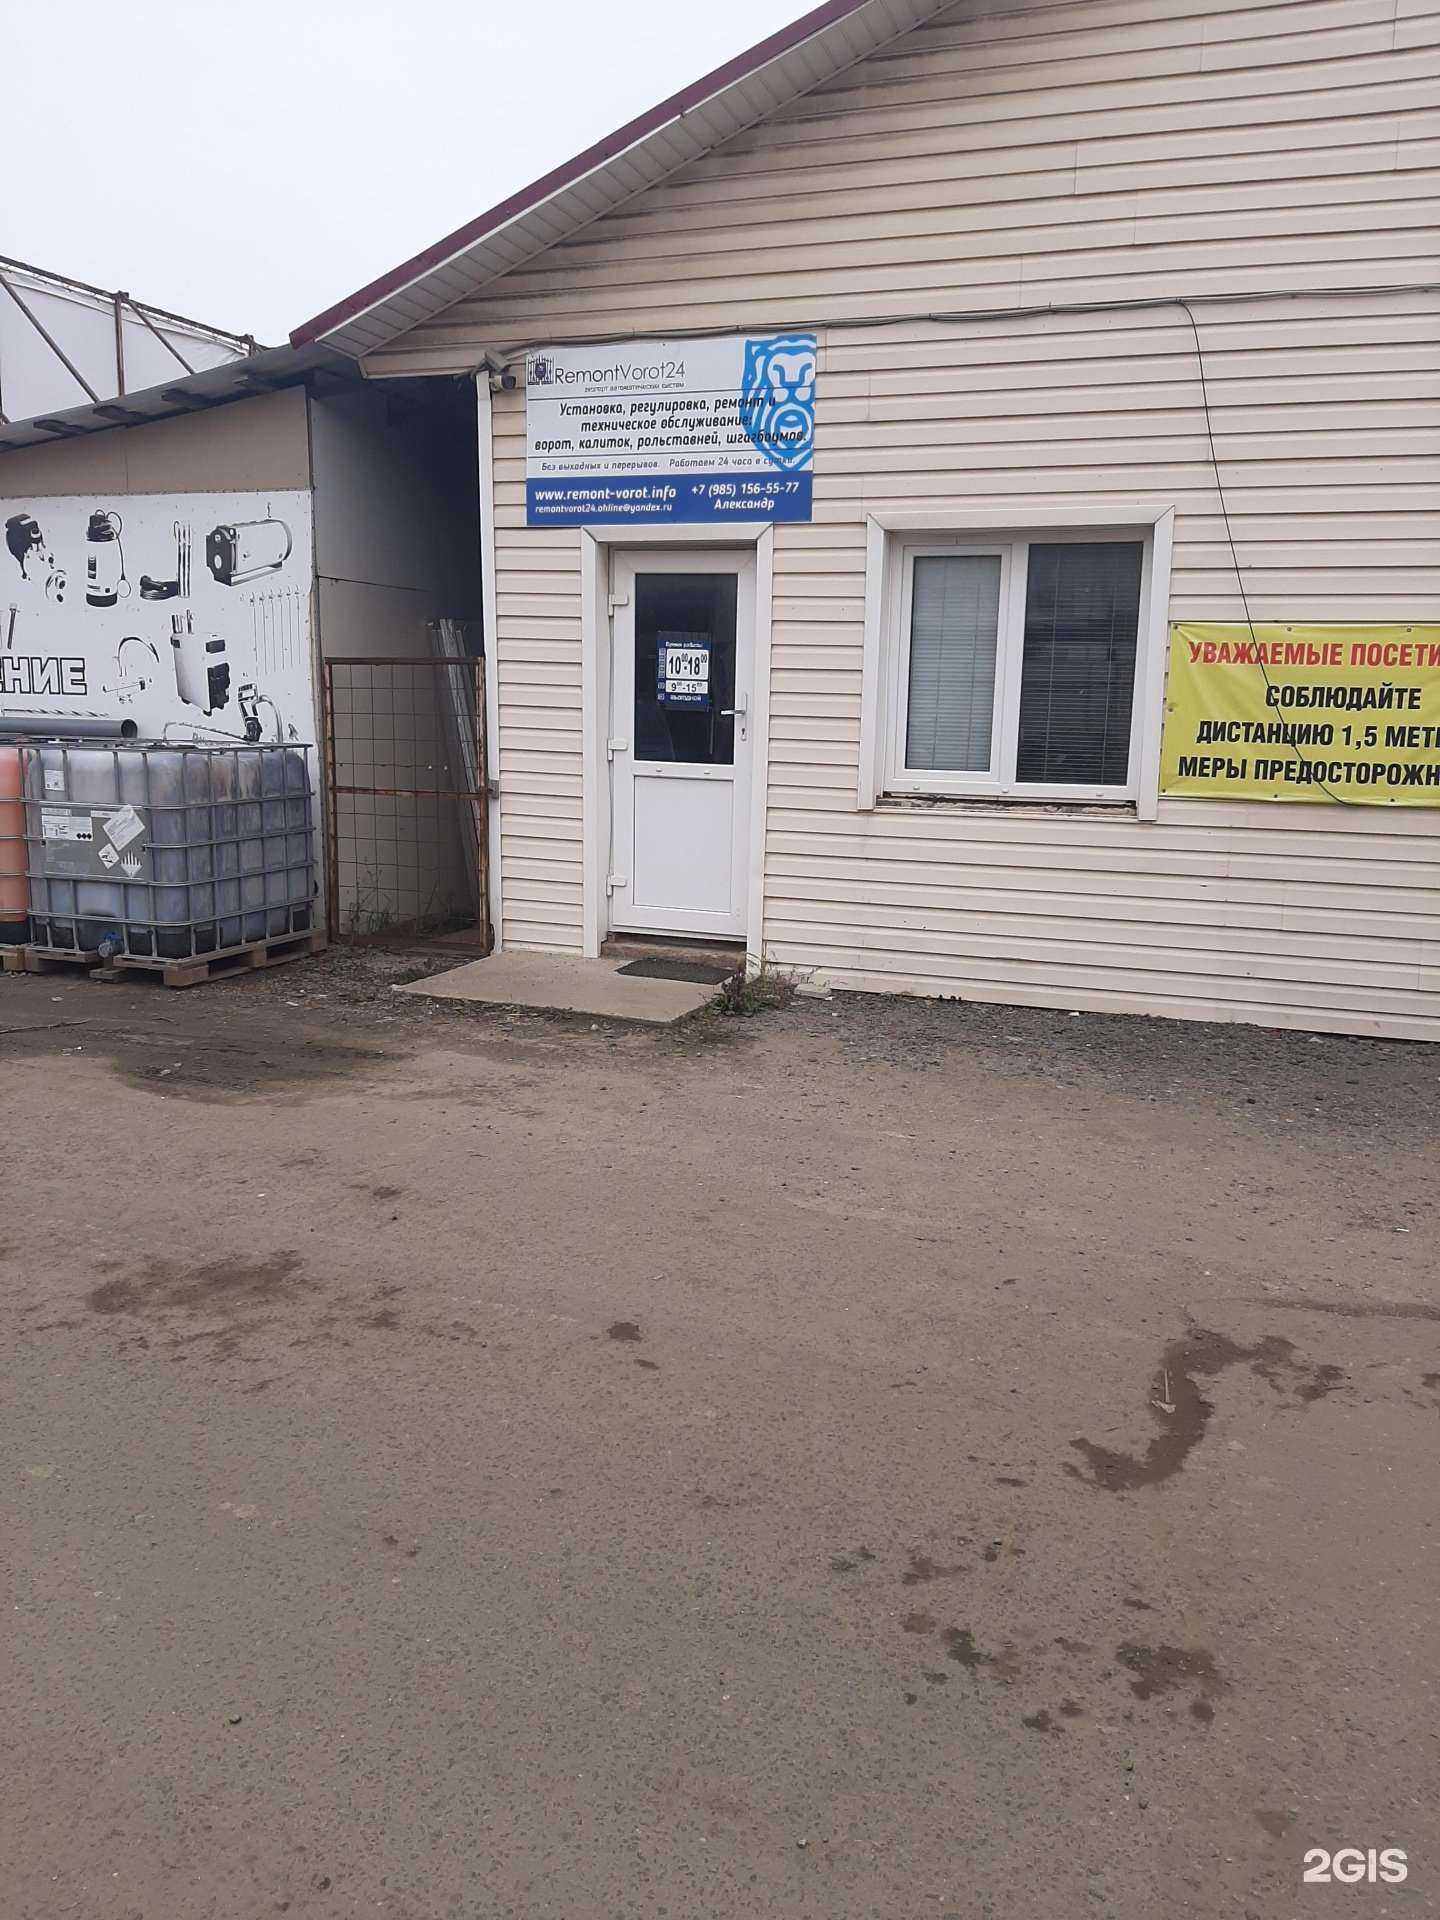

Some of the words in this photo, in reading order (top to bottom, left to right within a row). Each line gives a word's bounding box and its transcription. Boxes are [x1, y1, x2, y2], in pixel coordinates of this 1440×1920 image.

[554, 360, 685, 385] RemontVorot24
[559, 402, 626, 417] Установка,
[629, 400, 710, 416] регулировка,
[714, 397, 764, 412] ремонт
[768, 397, 776, 407] и
[581, 418, 657, 433] техническое
[661, 415, 753, 431] обслуживание:
[535, 438, 575, 453] ворот,
[579, 436, 633, 450] калиток,
[637, 431, 722, 450] рольставней,
[541, 462, 556, 471] Без
[559, 461, 601, 471] выходных
[669, 458, 715, 468] Работаем
[718, 456, 729, 466] 24
[732, 457, 752, 466] часа
[535, 484, 677, 502] www.remont-vorot.info
[691, 484, 705, 495] +7
[708, 483, 737, 498] (985)
[741, 481, 800, 495] 156-55-77
[714, 497, 775, 511] Александр
[1188, 641, 1344, 666] УВАЖАЕМЫЕ
[0, 656, 87, 696] НИЕ
[1265, 682, 1422, 711] СОБЛЮДАЙТЕ
[1196, 720, 1334, 747] ДИСТАНЦИЮ
[1342, 725, 1377, 750] 1,5
[1178, 756, 1248, 780] МЕРЫ
